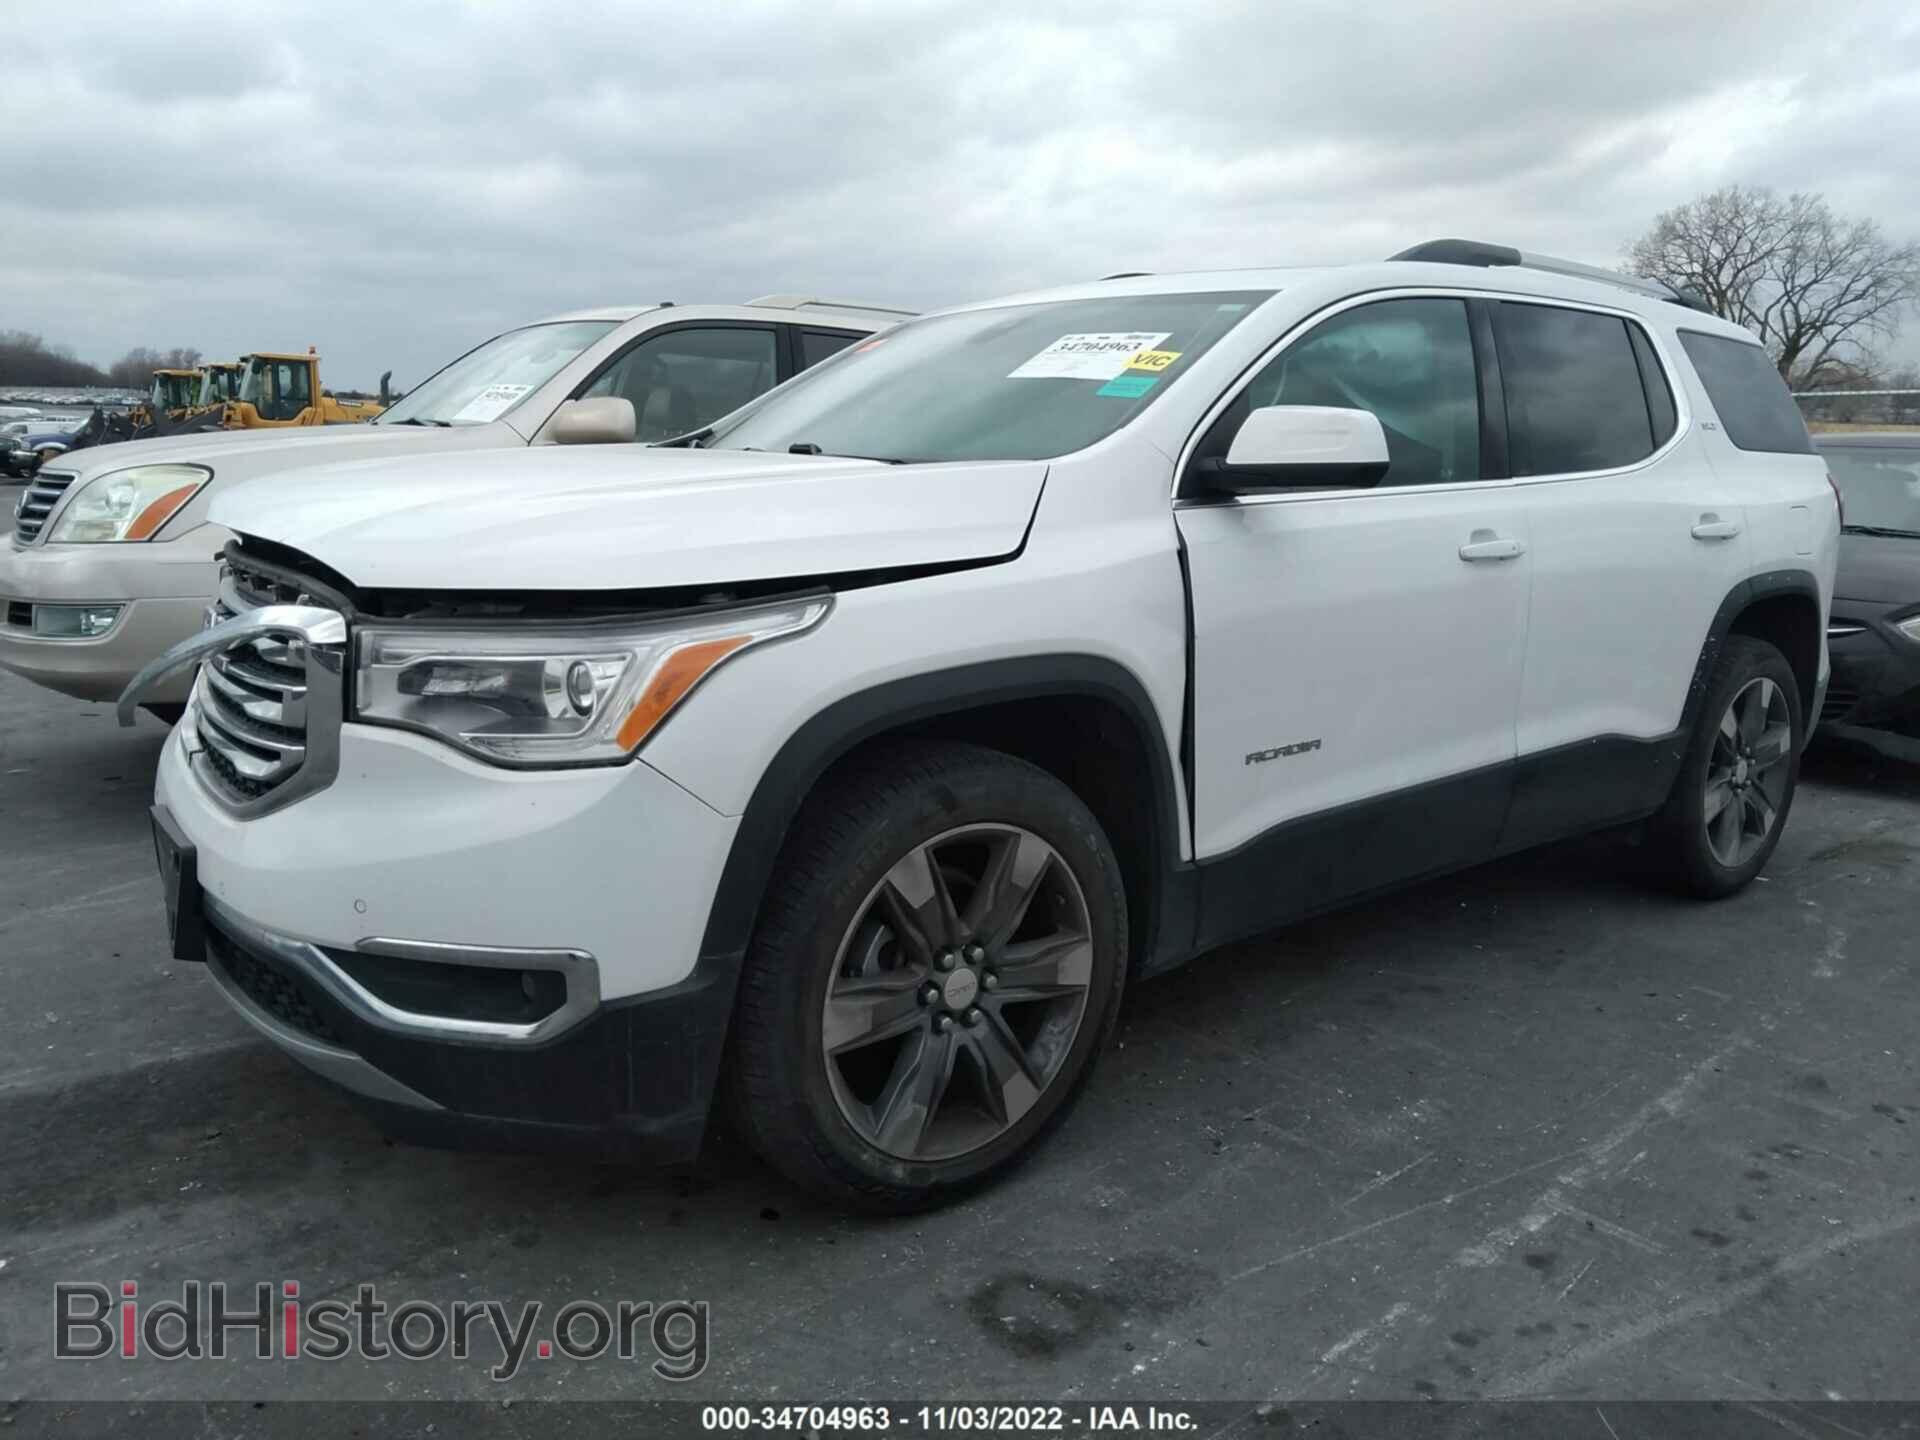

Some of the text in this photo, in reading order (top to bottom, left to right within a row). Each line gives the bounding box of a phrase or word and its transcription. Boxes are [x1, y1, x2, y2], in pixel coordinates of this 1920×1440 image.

[1053, 341, 1143, 352] 34704963
[1133, 353, 1171, 367] VIC
[1245, 739, 1321, 765] ACADIA
